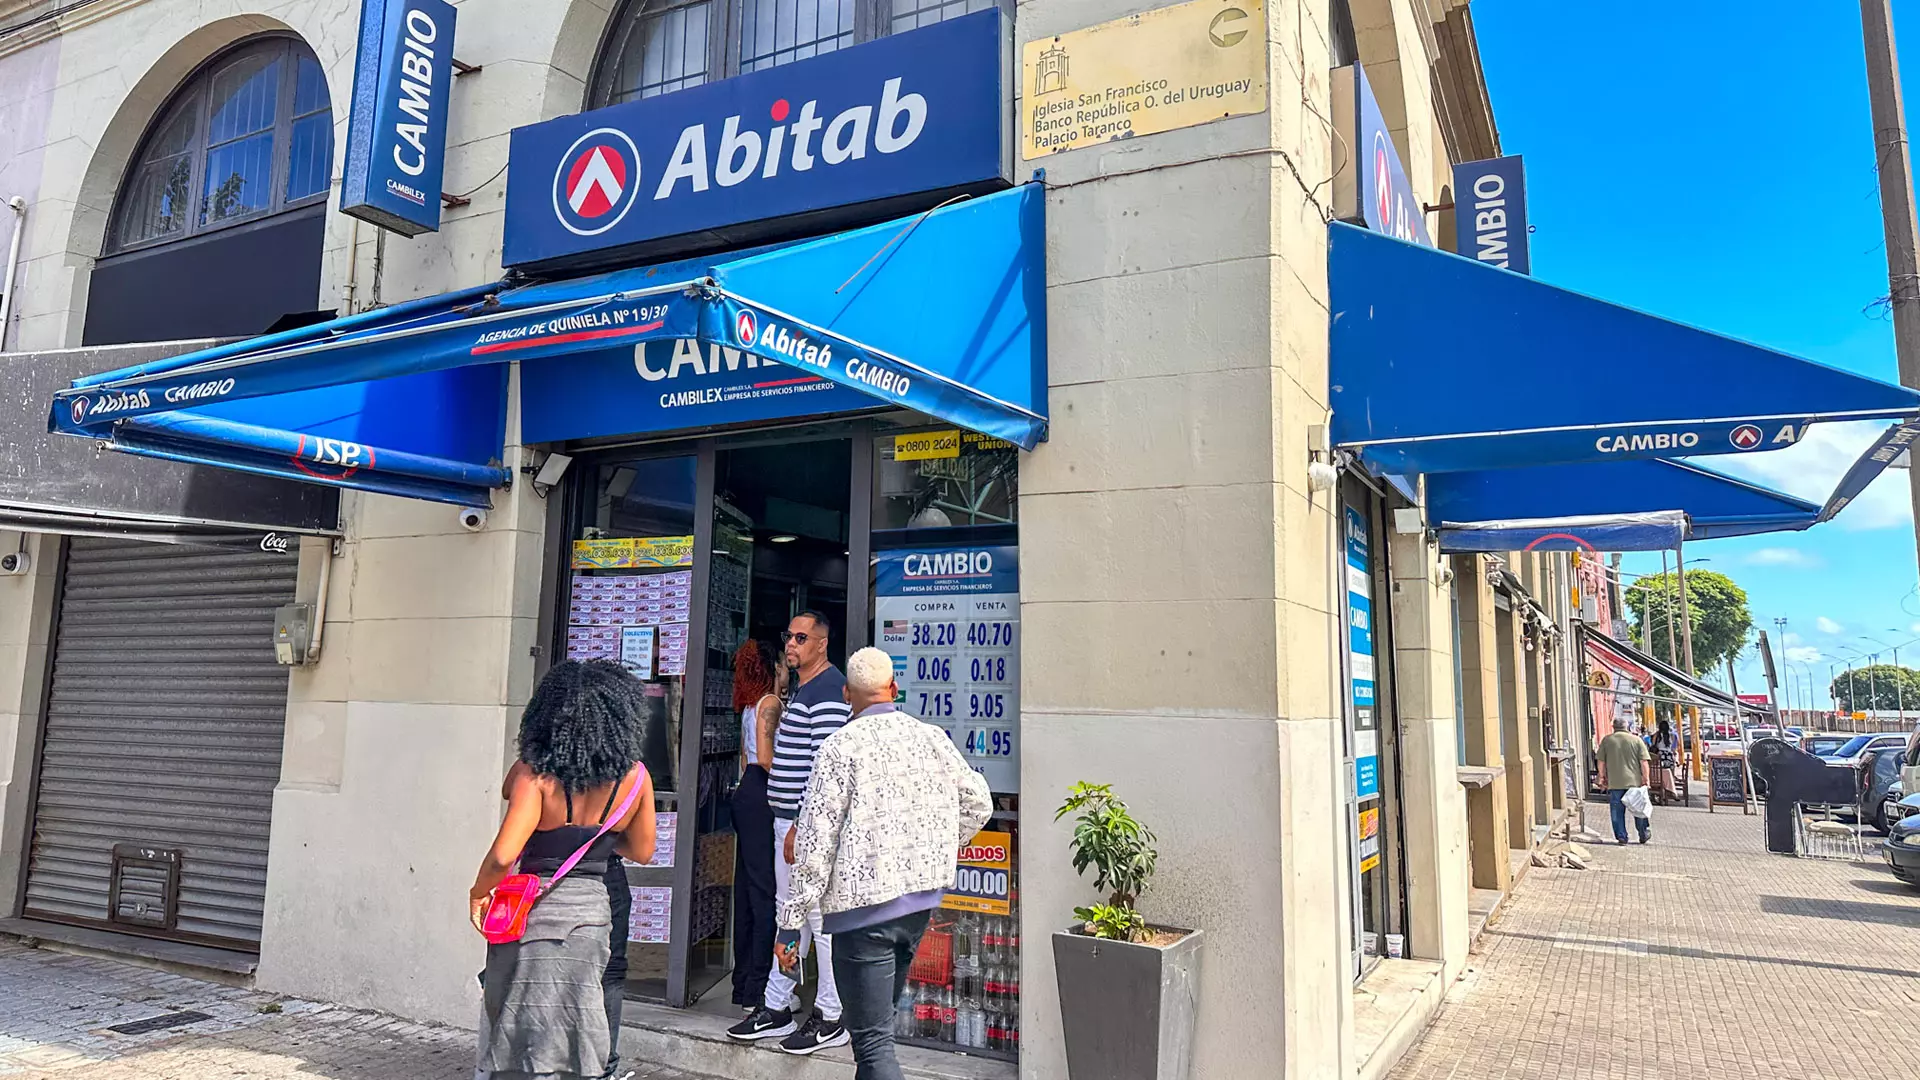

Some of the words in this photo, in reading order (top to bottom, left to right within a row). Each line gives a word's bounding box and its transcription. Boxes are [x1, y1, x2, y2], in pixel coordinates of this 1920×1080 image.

[393, 9, 437, 176] CAMBIO
[1035, 98, 1074, 119] Iglesia
[1079, 94, 1101, 107] San
[1106, 79, 1168, 100] Francisco
[1035, 115, 1072, 133] Banco
[1076, 98, 1140, 124] República
[1144, 95, 1158, 109] O.
[1163, 89, 1185, 105] del
[1189, 78, 1251, 100] Uruguay
[653, 76, 928, 201] Abitab
[1035, 130, 1077, 148] Palacio
[1083, 119, 1132, 138] Taranco
[386, 178, 425, 200] CAMBILEX
[475, 326, 526, 344] AGENCIA
[529, 322, 545, 335] DE
[549, 314, 610, 333] QUINIELA
[632, 304, 669, 321] 19/30
[760, 322, 832, 368] Abitab
[845, 358, 911, 396] CAMBIO
[89, 388, 151, 415] Abitab
[165, 378, 235, 402] CAMBIO
[660, 387, 723, 408] CAMBILEX
[724, 391, 751, 401] EMPRESA
[752, 390, 760, 398] DE
[761, 386, 793, 397] SERVICIOS
[793, 382, 834, 393] FINANCIEROS
[906, 440, 930, 452] 0800
[933, 438, 957, 450] 2024
[978, 440, 1012, 450] UNION
[1596, 432, 1699, 453] CAMBIO
[260, 532, 287, 553] Coca
[903, 551, 993, 576] CAMBIO
[914, 603, 955, 612] COMPRA
[975, 602, 1007, 610] VENTA
[912, 622, 956, 646] 38.20
[967, 622, 1012, 647] 40.70
[917, 657, 950, 681] 0.06
[971, 657, 1005, 681] 0.18
[920, 693, 953, 716] 7.15
[970, 693, 1004, 718] 9.05
[966, 730, 1011, 756] 44.95
